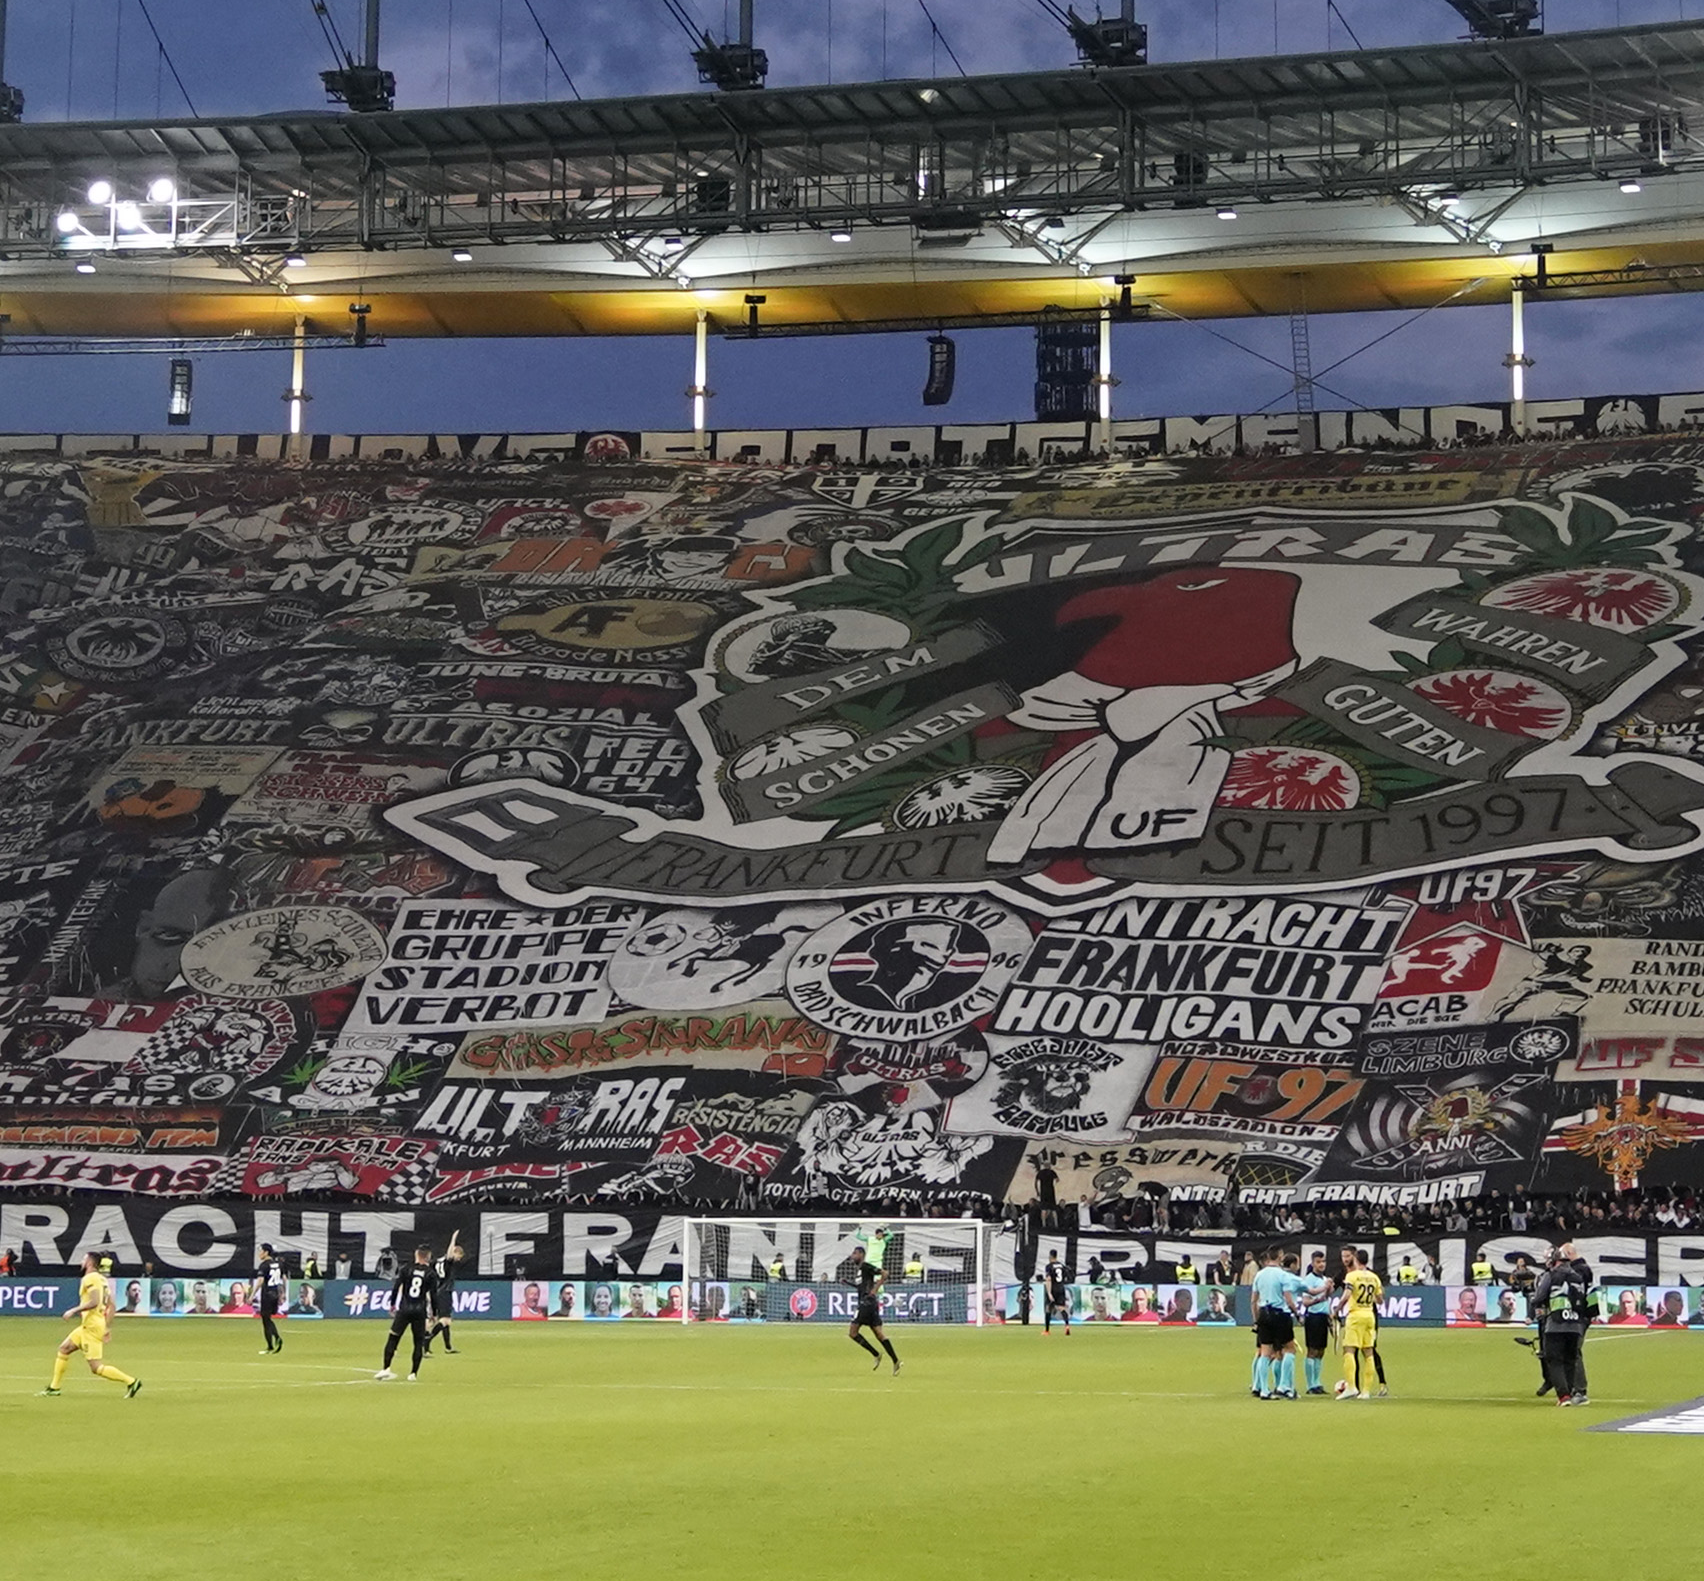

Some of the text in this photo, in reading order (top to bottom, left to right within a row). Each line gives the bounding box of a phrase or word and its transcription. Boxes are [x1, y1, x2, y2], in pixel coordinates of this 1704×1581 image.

[952, 523, 1536, 593] ULTRAS
[1411, 607, 1608, 677] WAHREN
[776, 647, 937, 712] DEM
[450, 701, 659, 726] ASOZIAL
[1322, 684, 1486, 769] GUTEN
[1111, 809, 1196, 841] UF
[614, 788, 1567, 894] FRANKFURT SEIT 1997
[1417, 868, 1538, 905] UF97
[402, 903, 642, 931] EHRE DER
[850, 897, 1007, 930] INFERNO
[391, 926, 629, 961] GRUPPE
[375, 959, 610, 991] STADION
[798, 951, 1024, 970] 19 96
[1017, 935, 1385, 1005] FRANKFURT
[366, 988, 599, 1026] VERBOT
[995, 987, 1362, 1048] HOOLIGANS
[1372, 994, 1469, 1020] ACAB
[1361, 1044, 1510, 1075] LIMBURG
[1368, 1031, 1489, 1057] SZENE
[855, 1054, 947, 1081] ULTRAS
[1144, 1057, 1368, 1122] UF 97
[414, 1077, 686, 1141] ULT RAS
[254, 1136, 426, 1161] RADIKALE
[558, 1136, 654, 1153] MANNHEIM
[250, 1150, 403, 1171] FANS FFM
[764, 1182, 862, 1203] TOTGGTE
[1306, 1175, 1482, 1207] FRANKFURT
[268, 1268, 282, 1287] 20
[409, 1276, 423, 1298] 8
[1055, 1267, 1063, 1283] 3
[827, 1292, 945, 1317] REPECT
[1356, 1283, 1375, 1306] 28
